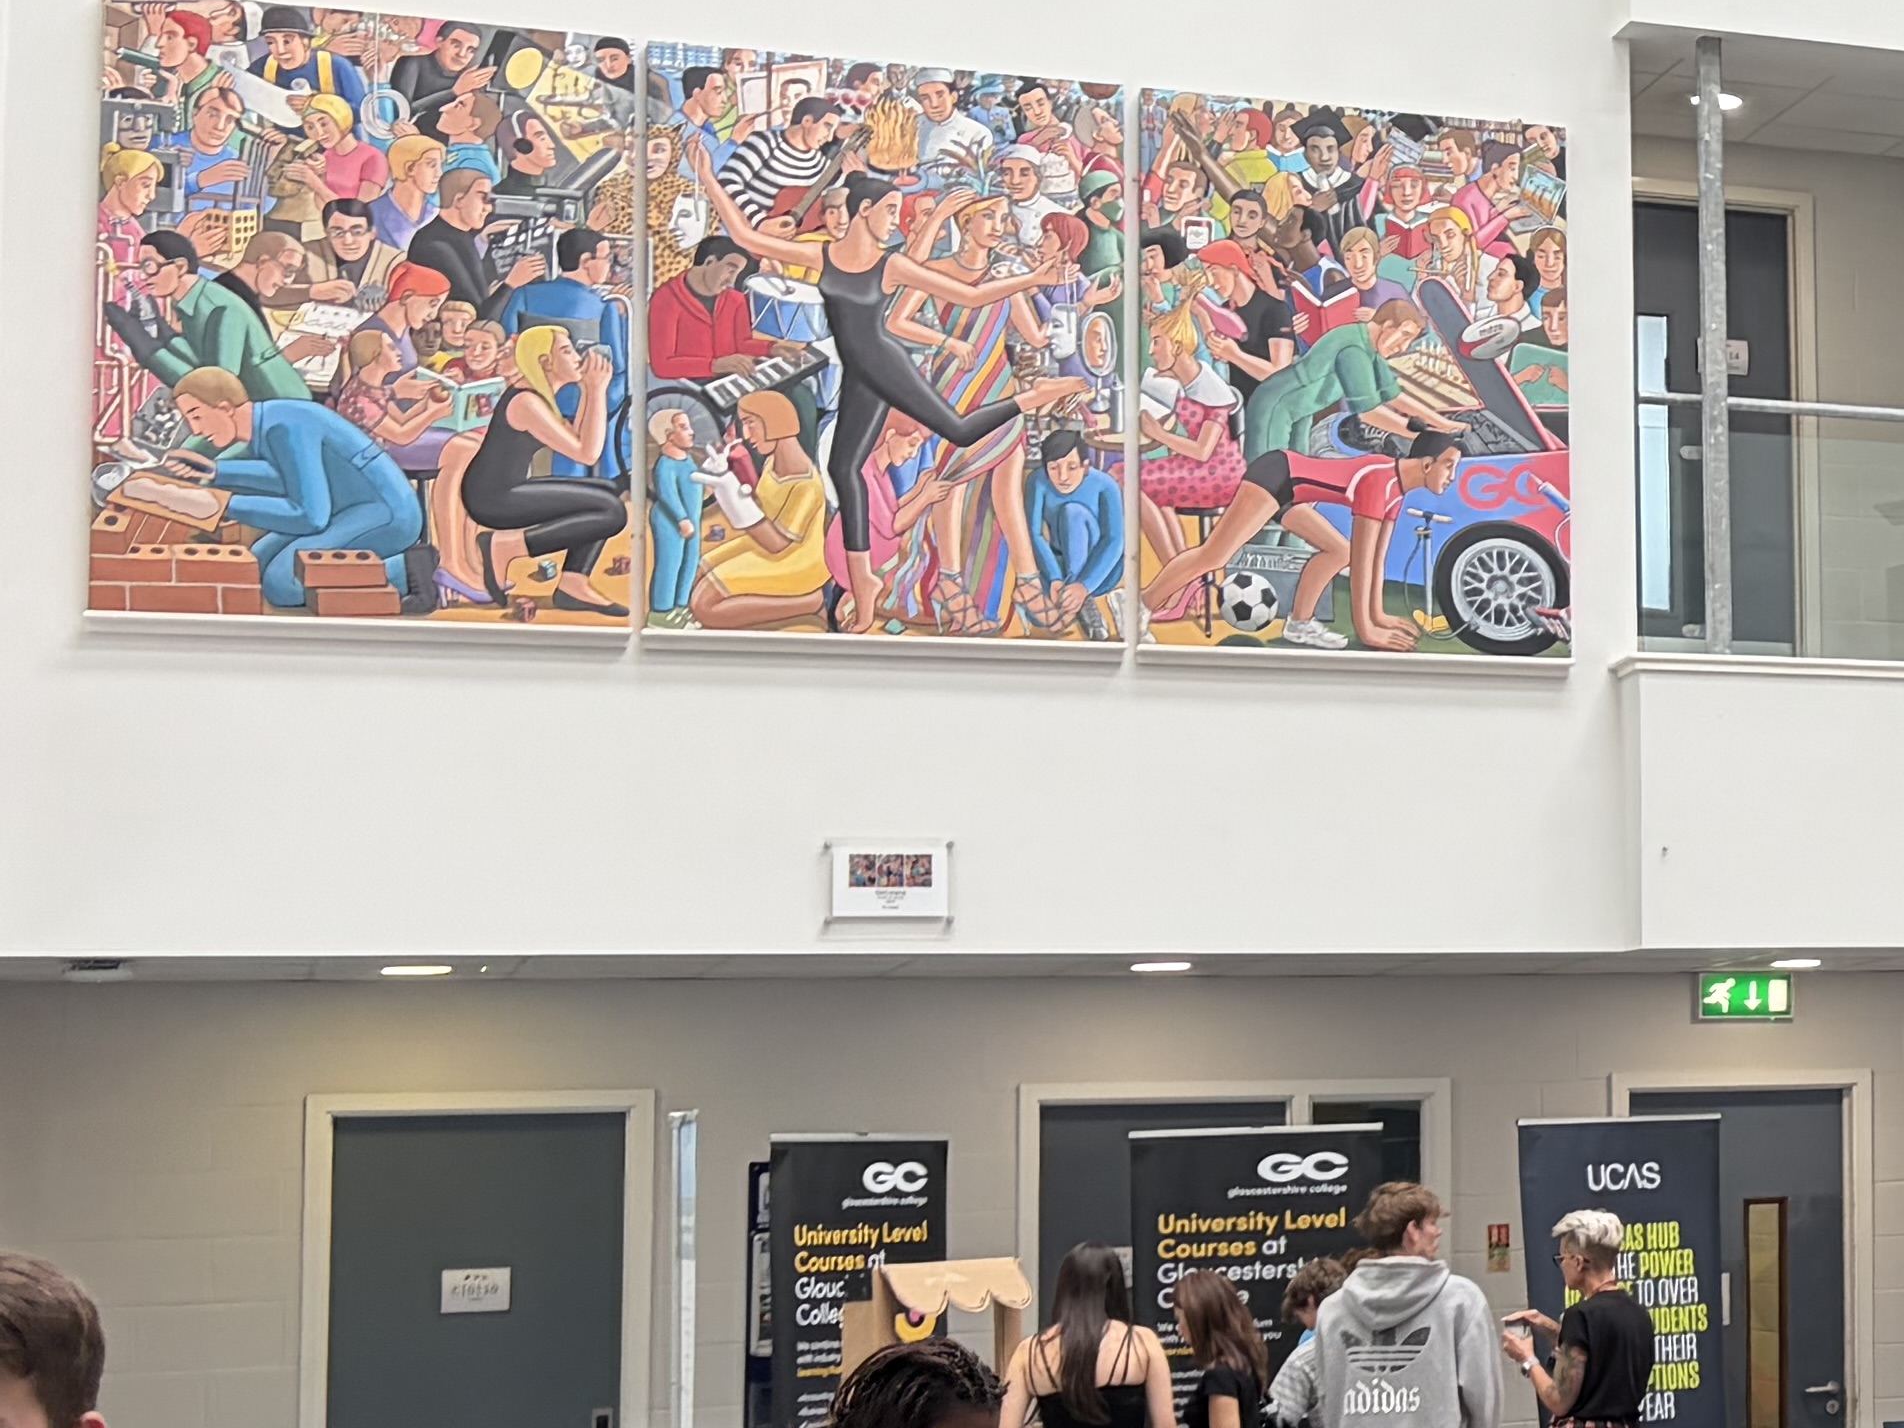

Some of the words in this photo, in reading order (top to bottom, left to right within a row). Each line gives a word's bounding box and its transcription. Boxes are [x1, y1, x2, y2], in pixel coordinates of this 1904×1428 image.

[862, 1161, 928, 1194] GC
[1257, 1151, 1349, 1182] GC
[1587, 1161, 1661, 1191] UCAS
[794, 1224, 880, 1249] University
[883, 1220, 928, 1244] Level
[1157, 1212, 1279, 1235] University
[1284, 1206, 1346, 1230] Level
[1647, 1221, 1680, 1249] HUB
[794, 1251, 865, 1272] Courses
[1157, 1239, 1257, 1259] Courses
[1262, 1235, 1288, 1255] at
[1640, 1248, 1694, 1277] POWER
[1636, 1278, 1655, 1307] TO
[1658, 1276, 1698, 1304] OVER
[1654, 1332, 1697, 1362] THEIR
[1343, 1378, 1421, 1415] adidas
